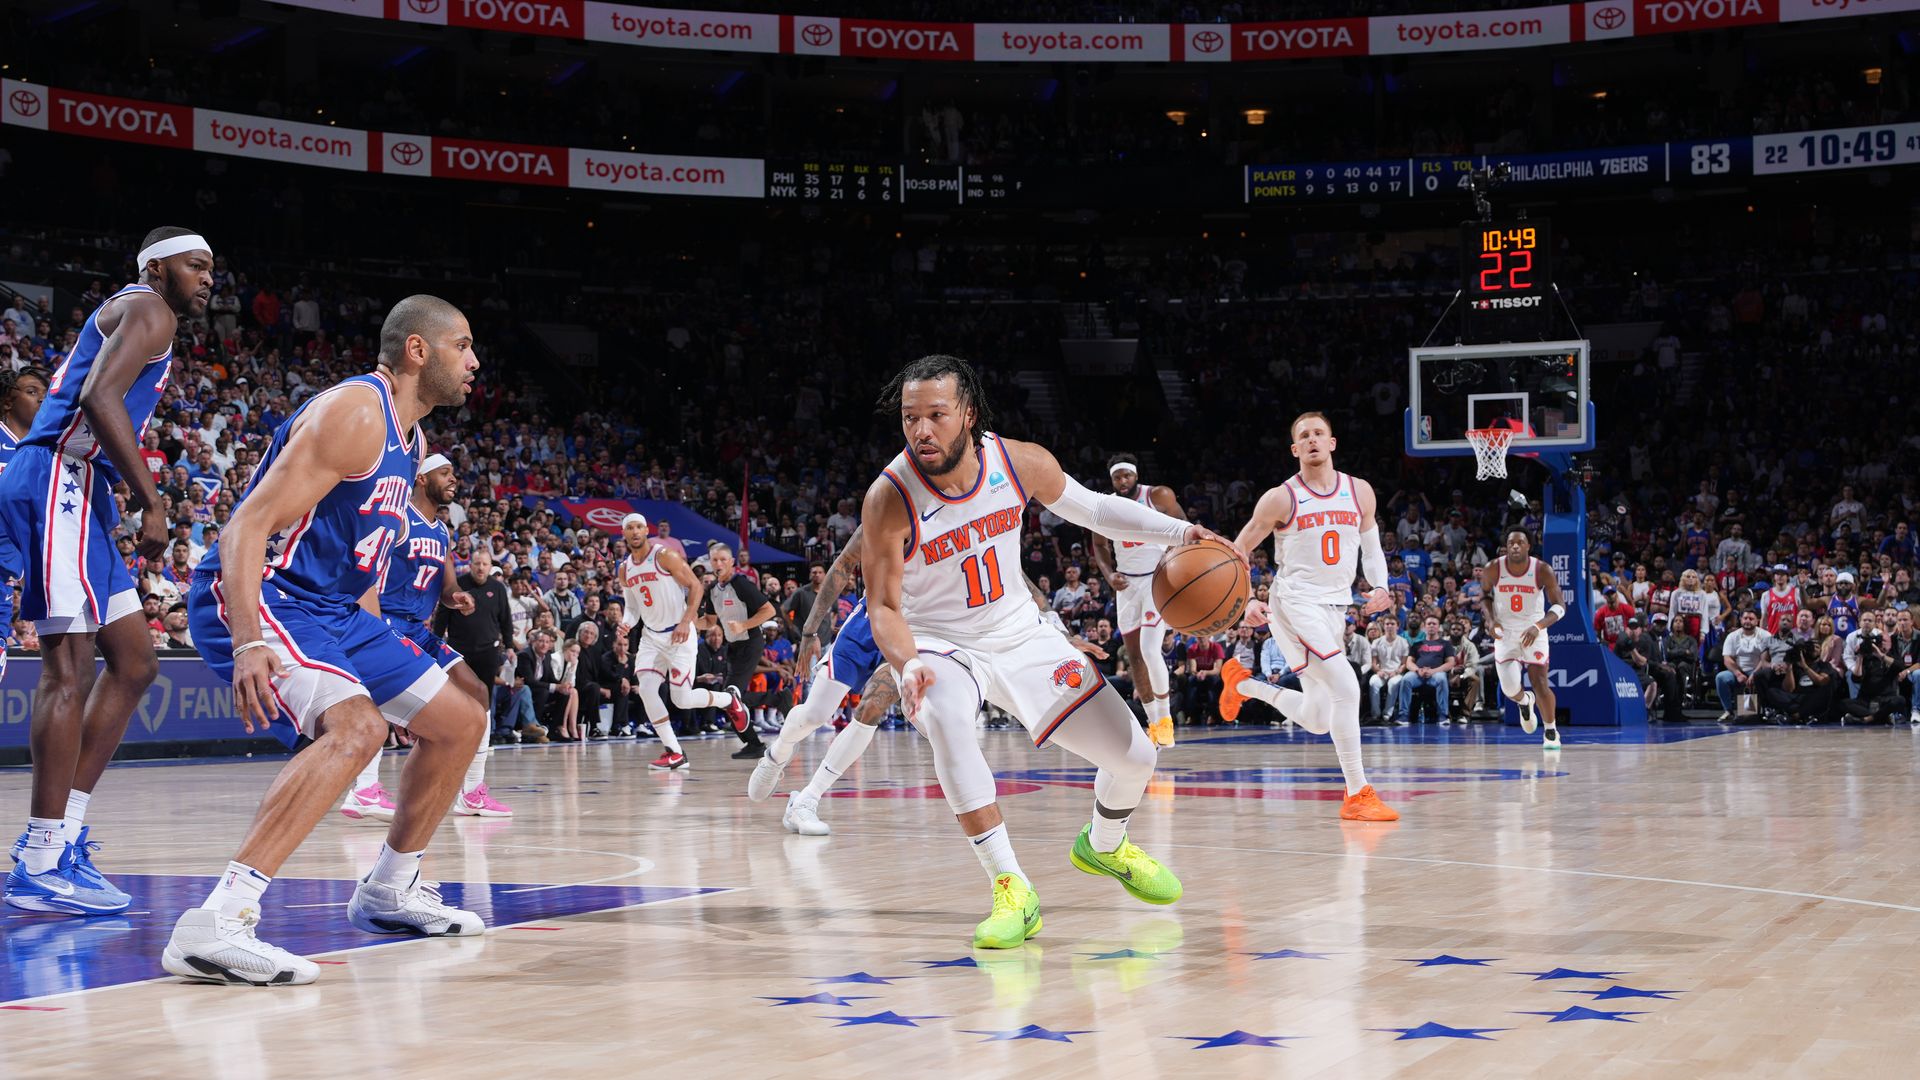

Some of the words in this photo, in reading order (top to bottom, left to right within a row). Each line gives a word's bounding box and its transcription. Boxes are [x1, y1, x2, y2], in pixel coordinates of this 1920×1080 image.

[463, 0, 570, 28] TOYOTA
[1644, 0, 1763, 25] TOYOTA
[611, 12, 753, 40] toyota.com
[1242, 25, 1354, 51] TOYOTA
[1397, 17, 1542, 45] toyota.com
[851, 27, 959, 52] TOYOTA
[1002, 30, 1143, 55] toyota.com
[58, 98, 178, 137] TOYOTA
[210, 119, 352, 156] toyota.com
[1765, 145, 1788, 165] 22
[1799, 129, 1896, 167] 10:49
[442, 146, 554, 176] TOYOTA
[585, 157, 725, 184] toyota.com
[828, 165, 845, 173] AST
[878, 167, 893, 175] STL
[1422, 162, 1441, 173] FLS
[1511, 159, 1594, 181] HILADELPHIA
[1600, 155, 1648, 176] 76ERS
[1691, 143, 1731, 176] 83
[773, 172, 794, 184] PHI
[804, 173, 819, 185] 35
[830, 175, 843, 186] 17
[857, 176, 866, 187] 4
[882, 177, 891, 188] 4
[905, 178, 937, 190] 10:58
[939, 180, 958, 191] PM
[1253, 170, 1296, 182] PLAYER
[1305, 169, 1314, 180] 9
[1326, 168, 1335, 179] 0
[1344, 167, 1360, 178] 40
[1366, 166, 1382, 178] 44
[1389, 165, 1401, 177] 17
[1425, 175, 1438, 191] 0
[770, 186, 797, 198] NYK
[804, 187, 819, 198] 39
[830, 188, 843, 199] 21
[857, 189, 866, 200] 6
[882, 190, 891, 201] 6
[967, 188, 984, 198] IND
[1254, 185, 1297, 197] POINTS
[1305, 184, 1314, 195] 9
[1326, 183, 1335, 194] 5
[1347, 182, 1359, 194] 13
[1369, 182, 1378, 193] 0
[1389, 181, 1401, 192] 17
[1483, 228, 1536, 252] 10:49
[1480, 250, 1532, 291] 22
[1490, 296, 1541, 309] TISSOT
[990, 482, 1010, 495] sphere
[1296, 511, 1325, 532] NEW
[1326, 510, 1358, 527] YORK
[920, 522, 971, 566] NEW
[970, 505, 1021, 544] YORK
[1321, 530, 1340, 566] 0
[354, 525, 395, 577] 40
[1552, 555, 1570, 571] GET
[413, 564, 439, 591] 17
[960, 545, 1005, 609] 11
[640, 586, 653, 607] 3
[1510, 594, 1523, 613] 8
[1837, 616, 1849, 631] 6
[1549, 633, 1565, 643] ogle
[1566, 633, 1585, 642] Pixel
